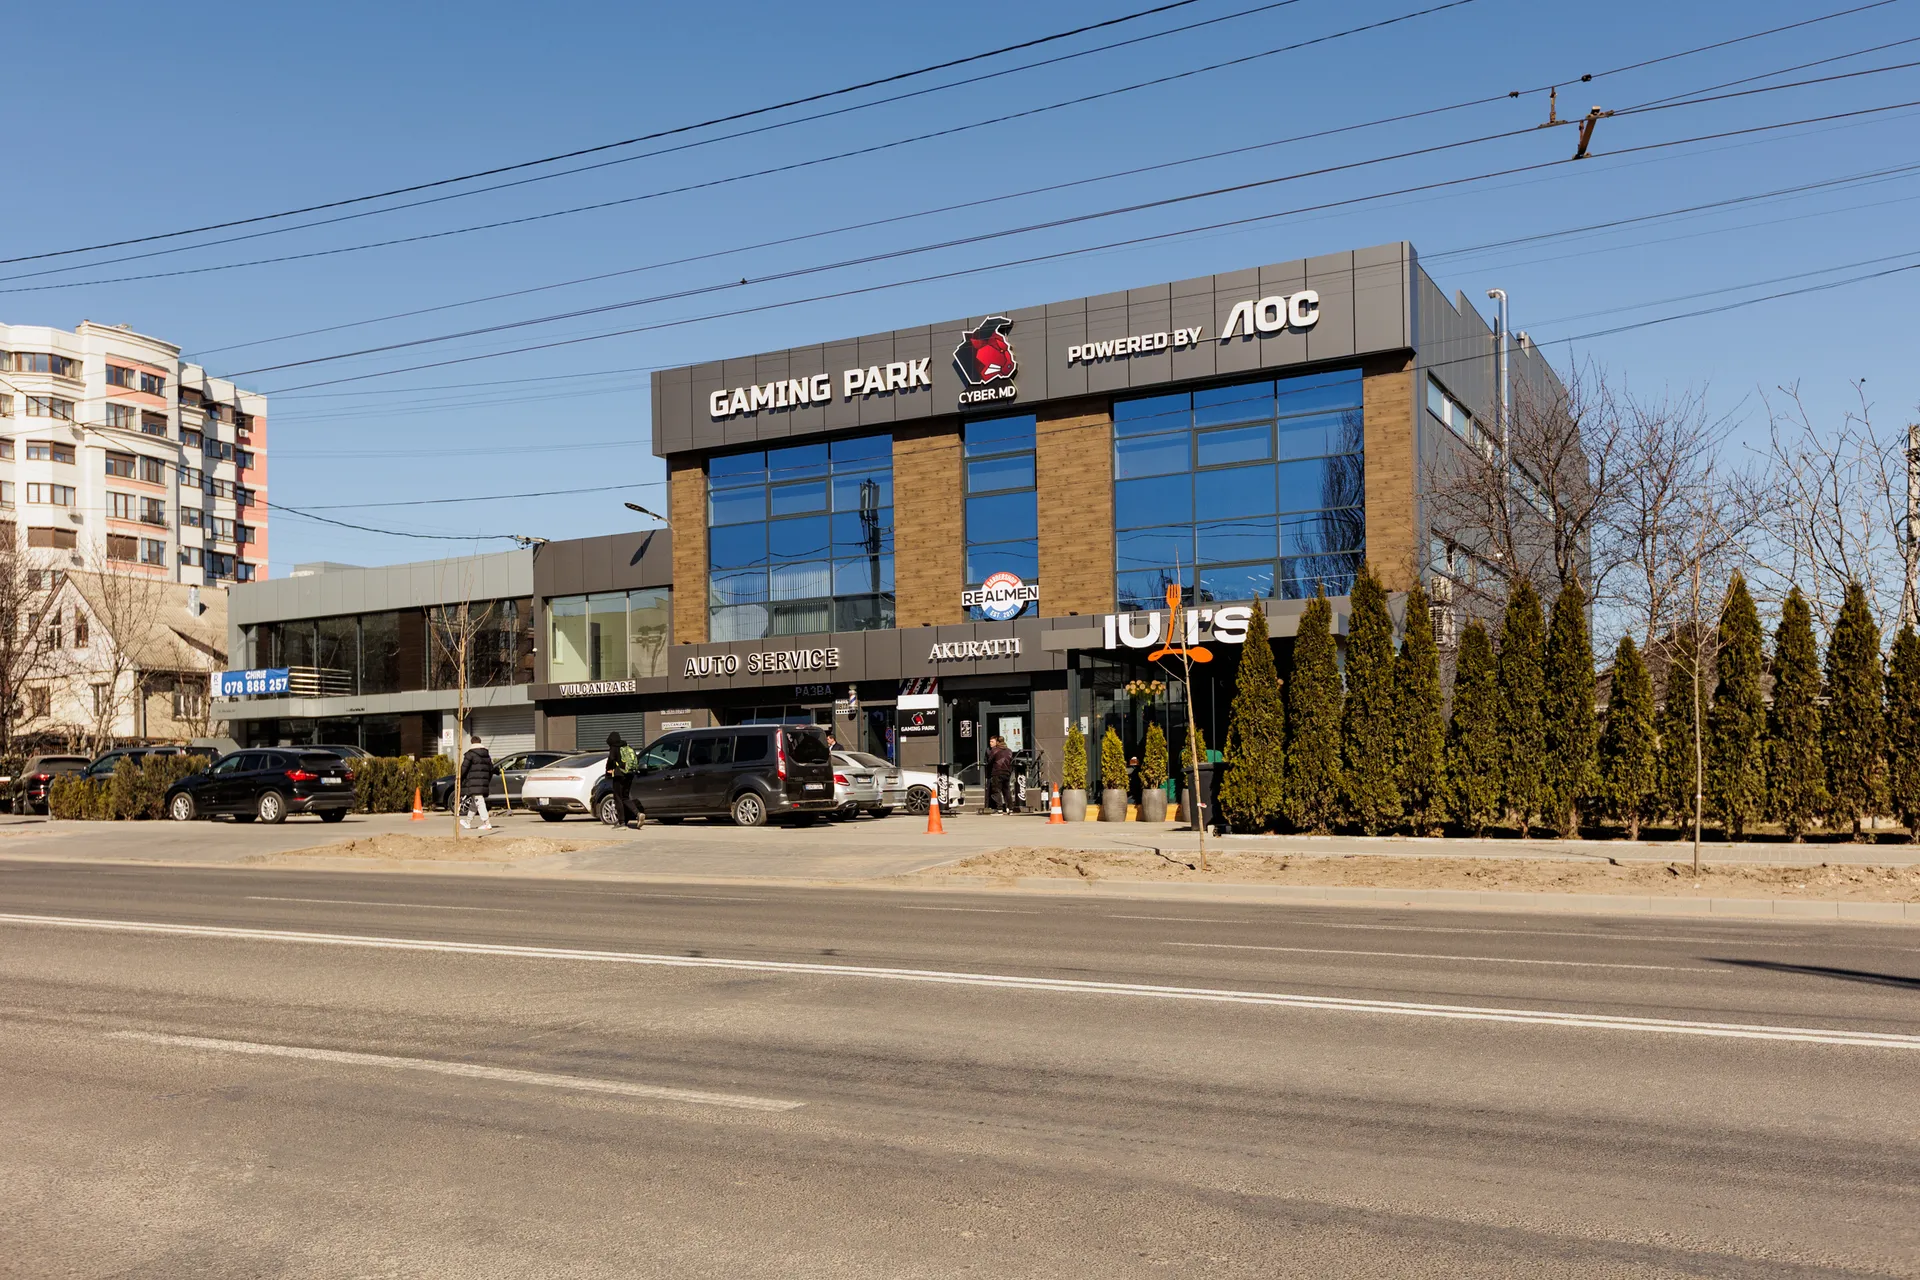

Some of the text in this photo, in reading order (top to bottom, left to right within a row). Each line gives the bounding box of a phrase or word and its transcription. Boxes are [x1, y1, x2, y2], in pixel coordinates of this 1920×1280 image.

[1220, 290, 1319, 339] AOC
[1068, 326, 1202, 362] POWERED BY
[709, 357, 931, 417] GAMING PARK
[959, 386, 1016, 403] CYBER.MD
[928, 638, 1020, 660] AKURATTI
[684, 647, 839, 677] AUTO SERVICE
[224, 677, 288, 694] 078 888 257
[245, 669, 267, 680] CHIRIE
[559, 680, 636, 696] VULCANIZARE
